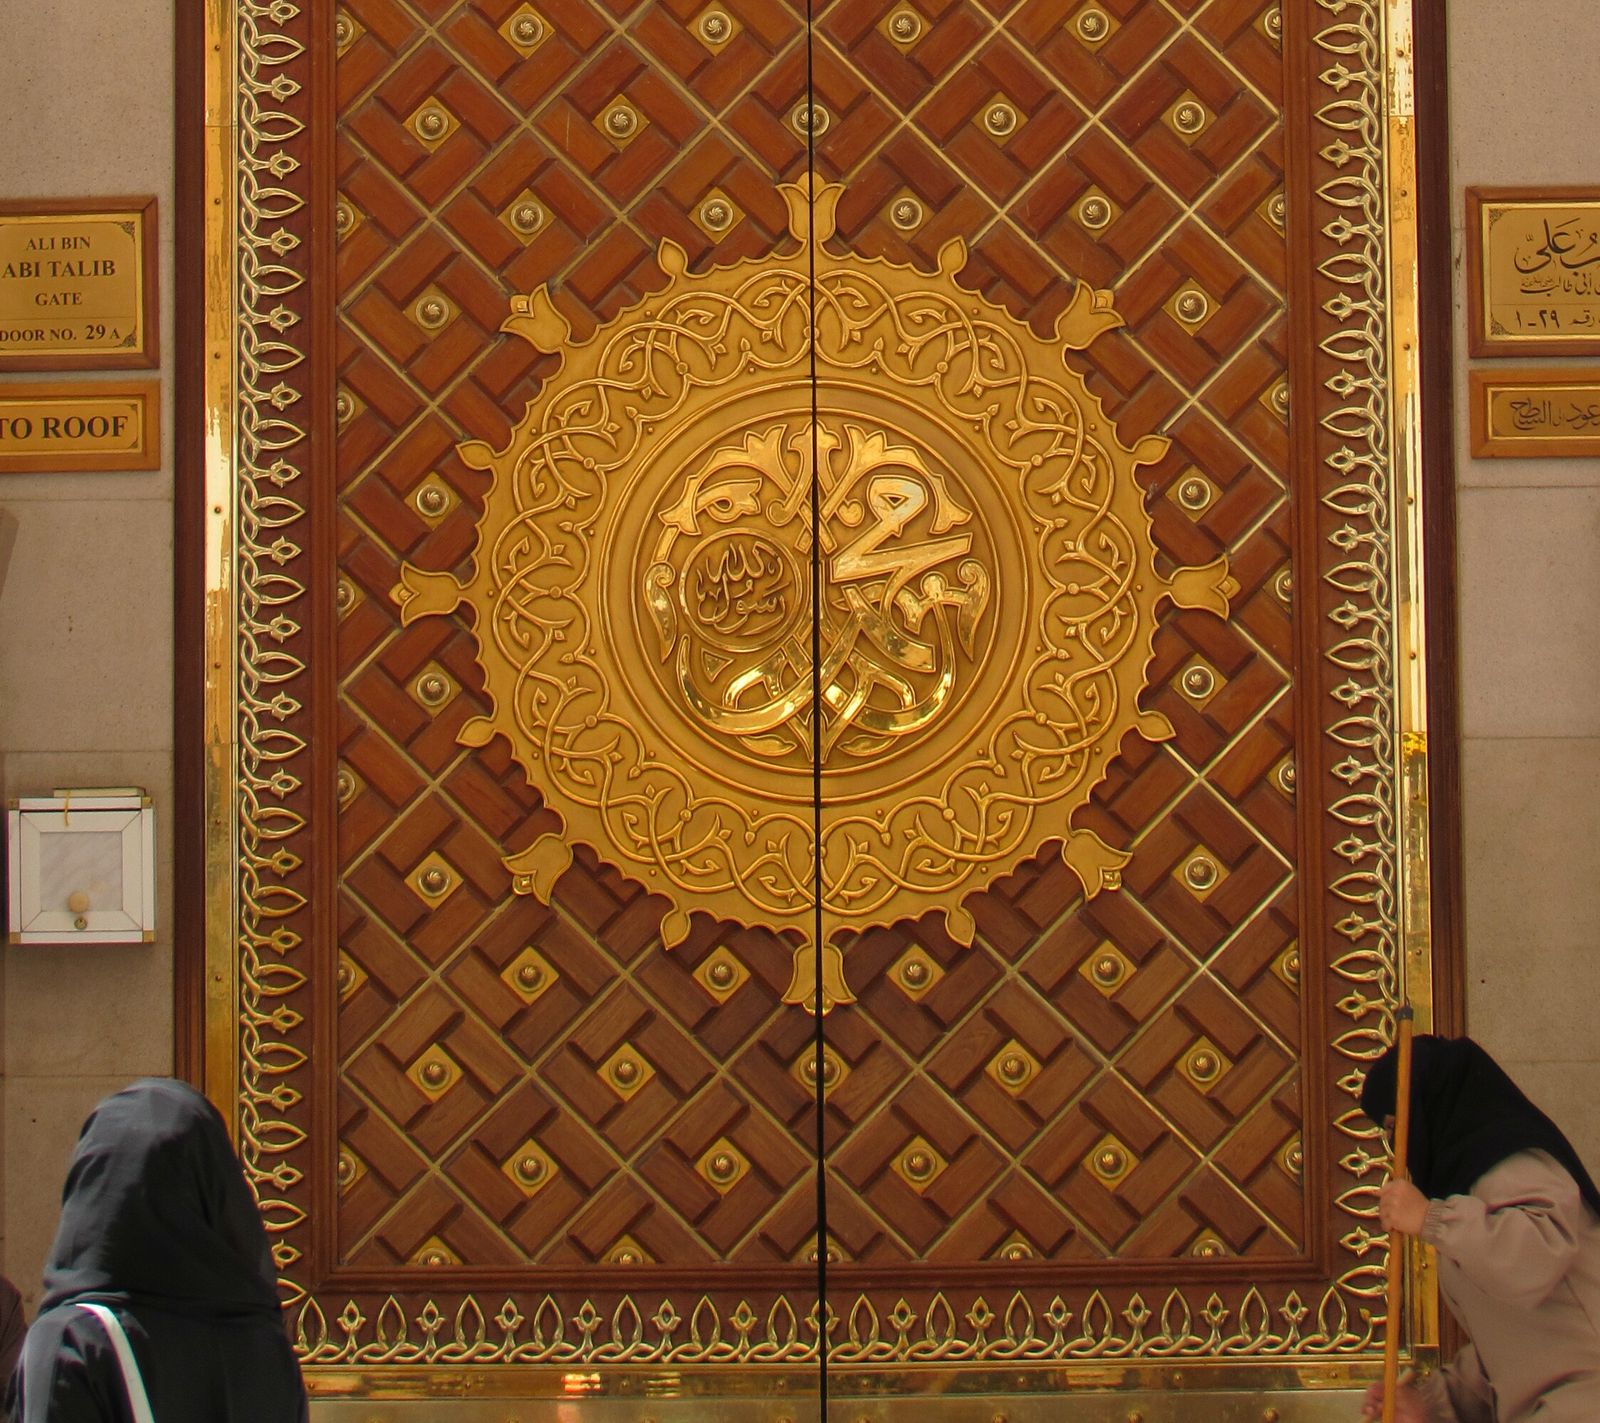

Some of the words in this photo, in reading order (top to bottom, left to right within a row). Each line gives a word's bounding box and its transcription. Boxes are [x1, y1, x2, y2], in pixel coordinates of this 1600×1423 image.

[26, 237, 55, 251] ALI
[61, 236, 91, 250] BIN
[1, 261, 41, 278] ABI
[47, 259, 116, 278] TALIB
[35, 292, 82, 306] GATE
[0, 329, 45, 342] DOOR
[49, 328, 77, 341] NO.
[85, 324, 106, 340] 29
[110, 328, 120, 339] A
[40, 415, 129, 439] ROOF
